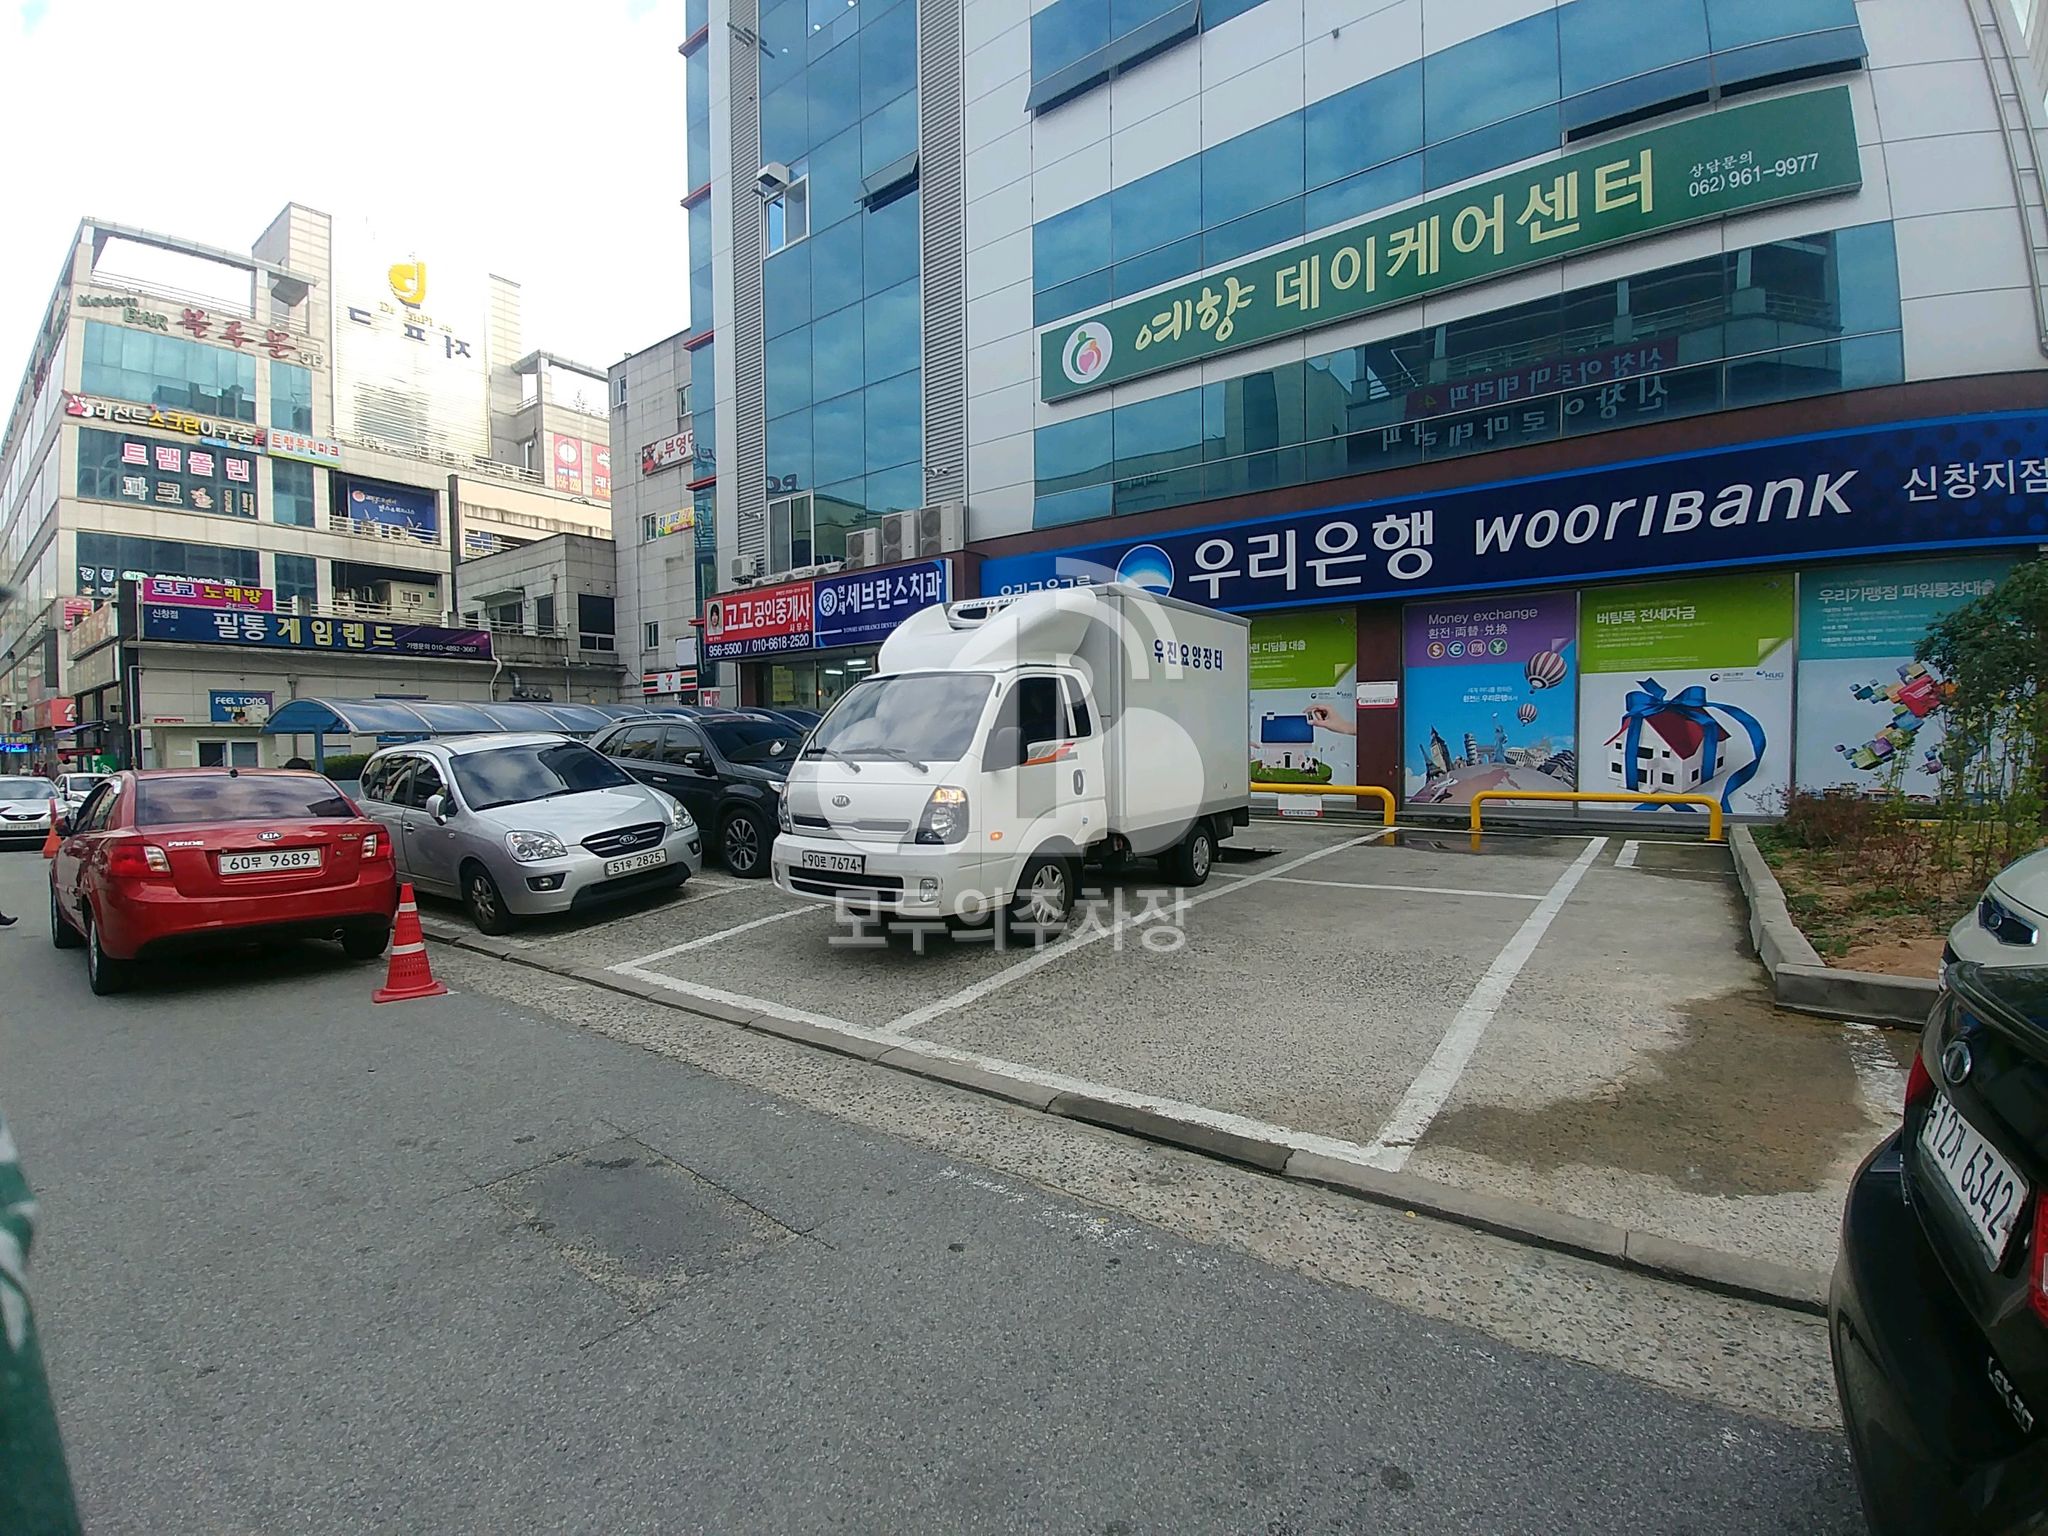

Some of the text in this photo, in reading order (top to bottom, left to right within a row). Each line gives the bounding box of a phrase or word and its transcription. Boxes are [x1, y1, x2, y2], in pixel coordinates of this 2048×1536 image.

[1690, 150, 1753, 180] 상담문의
[1134, 148, 1655, 352] 예향 데이케어센터
[122, 307, 169, 331] BAR
[121, 442, 250, 482] 트램폴린
[1902, 458, 2048, 502] 신창지점
[1189, 512, 1434, 591] 우리은행
[203, 586, 264, 604] 노래방
[1818, 585, 1898, 604] 우리가맹점
[152, 608, 180, 620] 신창점
[1428, 608, 1538, 625] Money exchange
[1596, 605, 1697, 625] 버팀목 전세자금
[213, 612, 396, 648] 필통 게임랜드
[708, 642, 742, 657] 956-5500
[752, 633, 810, 652] 010-6618-2520
[1153, 638, 1223, 671] 우진요양장터
[215, 697, 236, 705] FEEL
[262, 832, 281, 840] KIA
[270, 852, 311, 867] 9689
[636, 852, 662, 867] 2825
[831, 857, 858, 872] 7674
[1961, 1143, 2014, 1240] 6342
